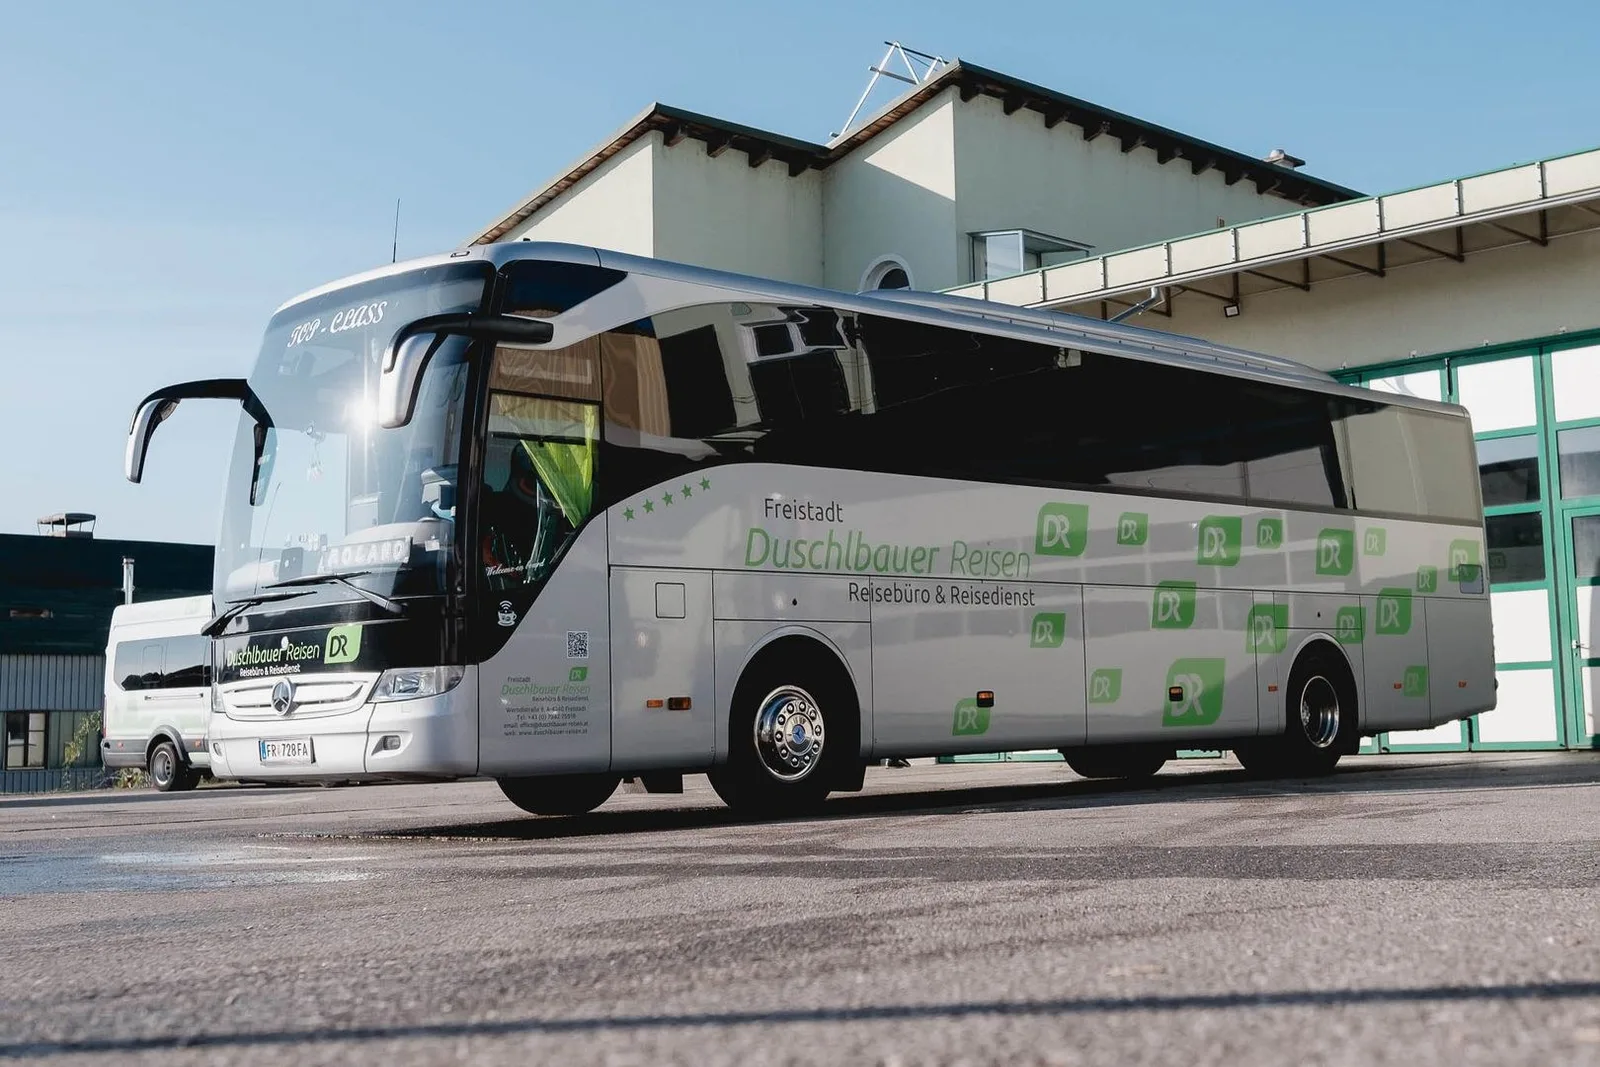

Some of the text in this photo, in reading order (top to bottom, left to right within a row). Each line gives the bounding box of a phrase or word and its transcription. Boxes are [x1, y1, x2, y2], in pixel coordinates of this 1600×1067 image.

[287, 318, 321, 348] TOP
[329, 300, 388, 334] CLASS
[764, 498, 844, 523] Freistadt
[1041, 513, 1071, 549] DR
[744, 528, 1031, 578] Duschlbauer Reisen
[848, 582, 1036, 607] Reisebüro & Reisedienst
[226, 641, 320, 668] Duschlbauer Reisen
[328, 634, 349, 658] DR
[239, 666, 265, 678] Reisebüro
[269, 663, 301, 676] Reisedienst
[501, 684, 561, 696] Duschlbauer
[266, 742, 309, 758] FR 728FA
